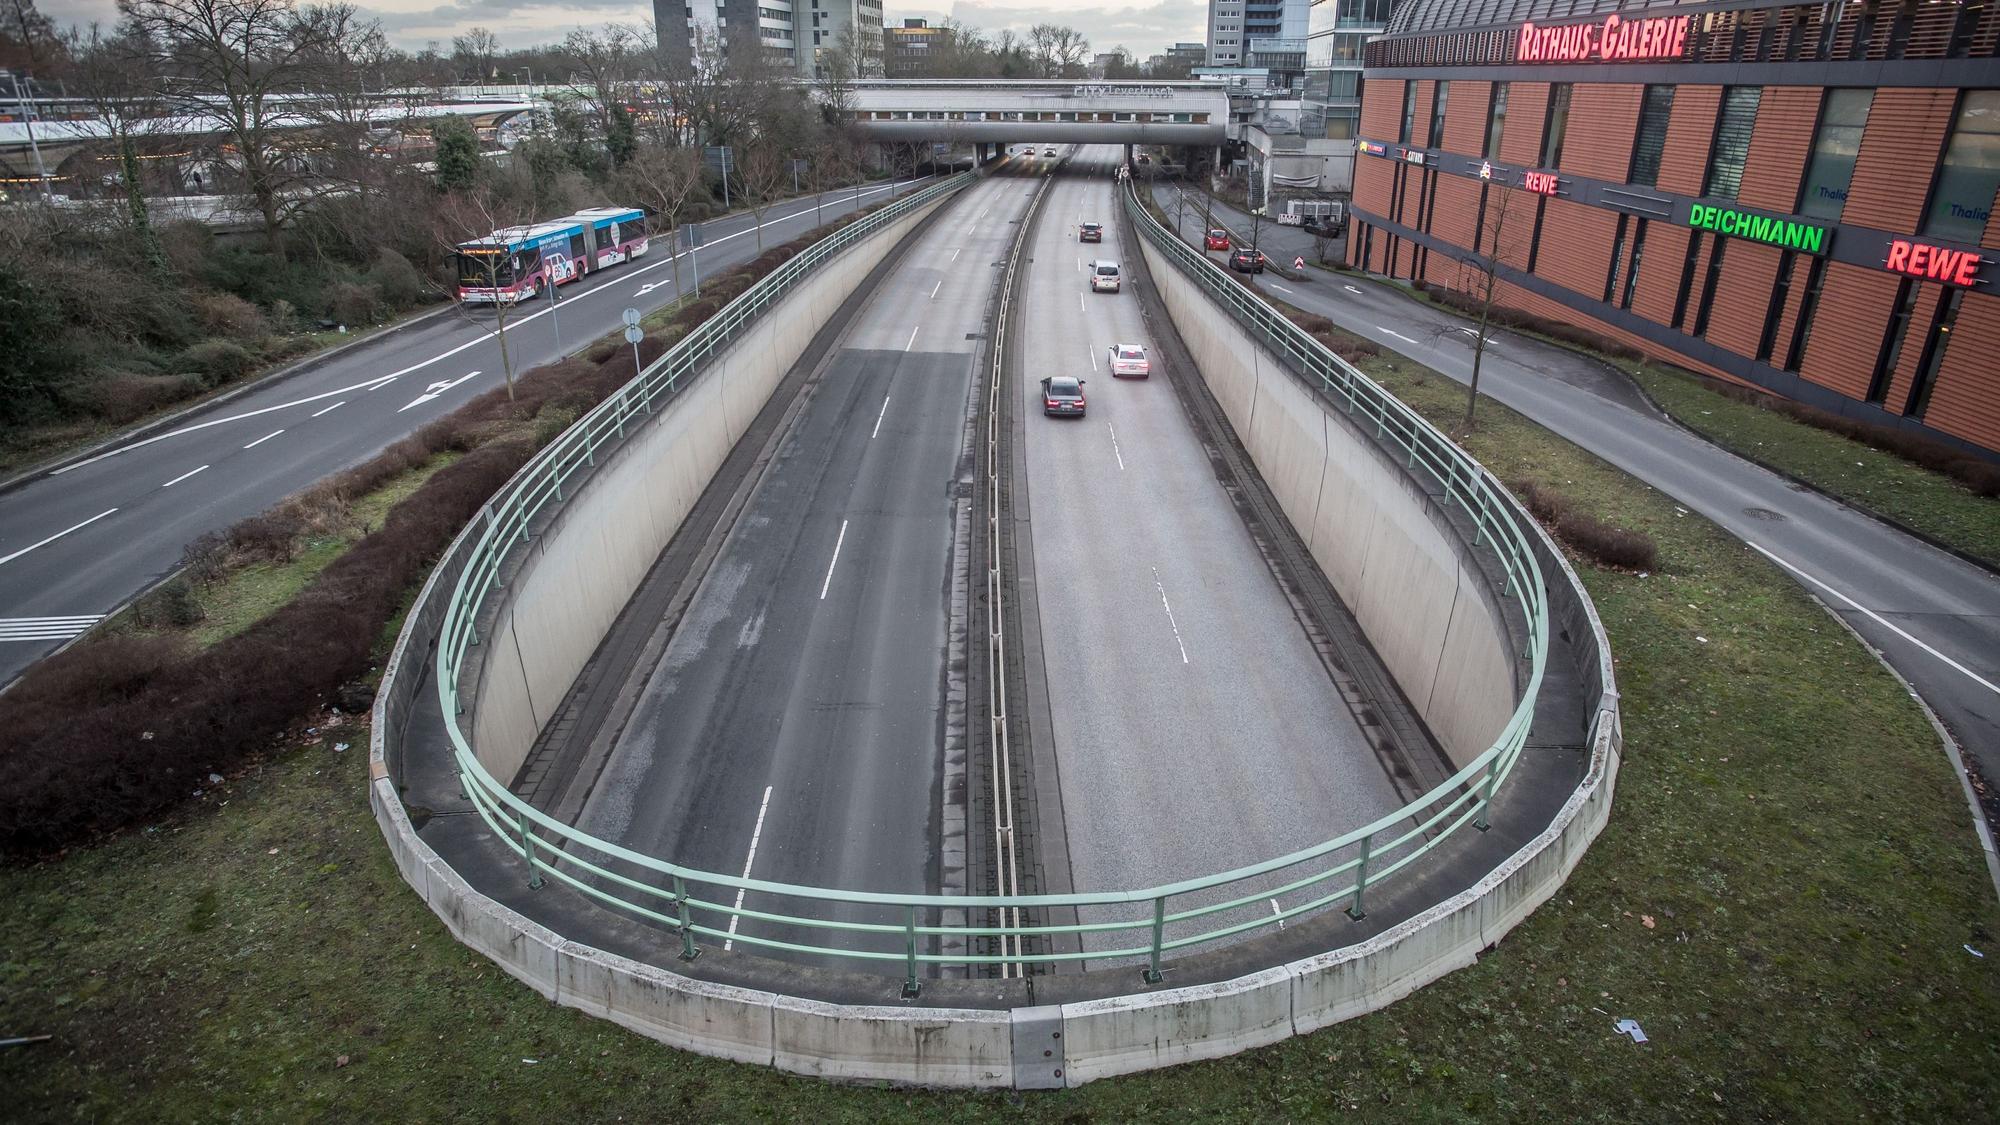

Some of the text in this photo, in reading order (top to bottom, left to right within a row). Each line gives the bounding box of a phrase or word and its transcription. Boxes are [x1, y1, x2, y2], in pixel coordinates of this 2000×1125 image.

[1518, 14, 1690, 61] RATHAUS-GALERIE
[1525, 171, 1558, 195] REWE
[1820, 186, 1848, 200] Thalia
[1689, 204, 1823, 252] DEICHMANN
[1951, 203, 1988, 221] Thalia
[1886, 240, 1980, 286] REWE
